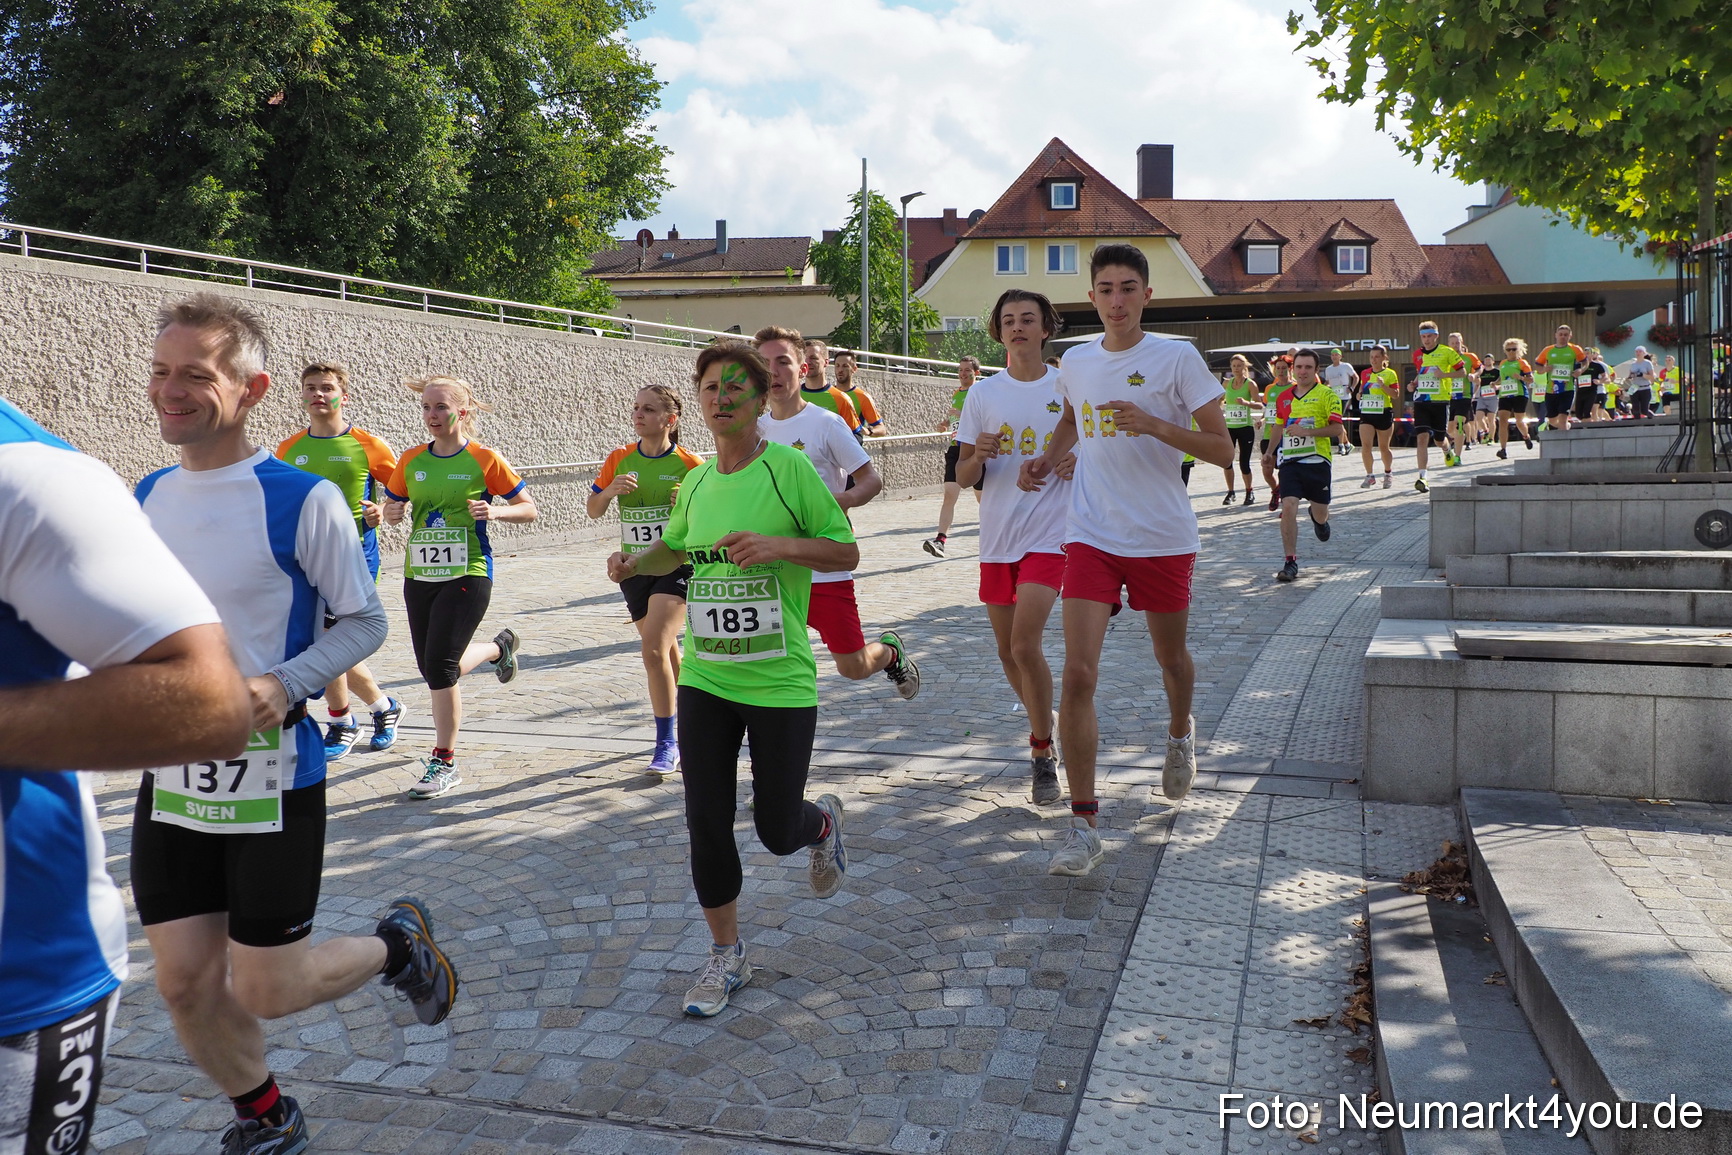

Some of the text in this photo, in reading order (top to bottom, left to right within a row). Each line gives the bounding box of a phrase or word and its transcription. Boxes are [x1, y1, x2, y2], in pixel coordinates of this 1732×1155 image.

[1288, 436, 1307, 447] 197
[622, 508, 670, 522] BOCK
[412, 529, 461, 542] BOCK
[630, 524, 662, 542] 131
[419, 546, 452, 564] 121
[421, 568, 451, 576] LAURA
[694, 579, 771, 600] BOCK
[705, 606, 760, 634] 183
[266, 759, 278, 767] E6
[183, 759, 249, 794] 137
[185, 800, 236, 820] SVEN
[59, 1024, 97, 1062] PW
[53, 1054, 94, 1118] 3
